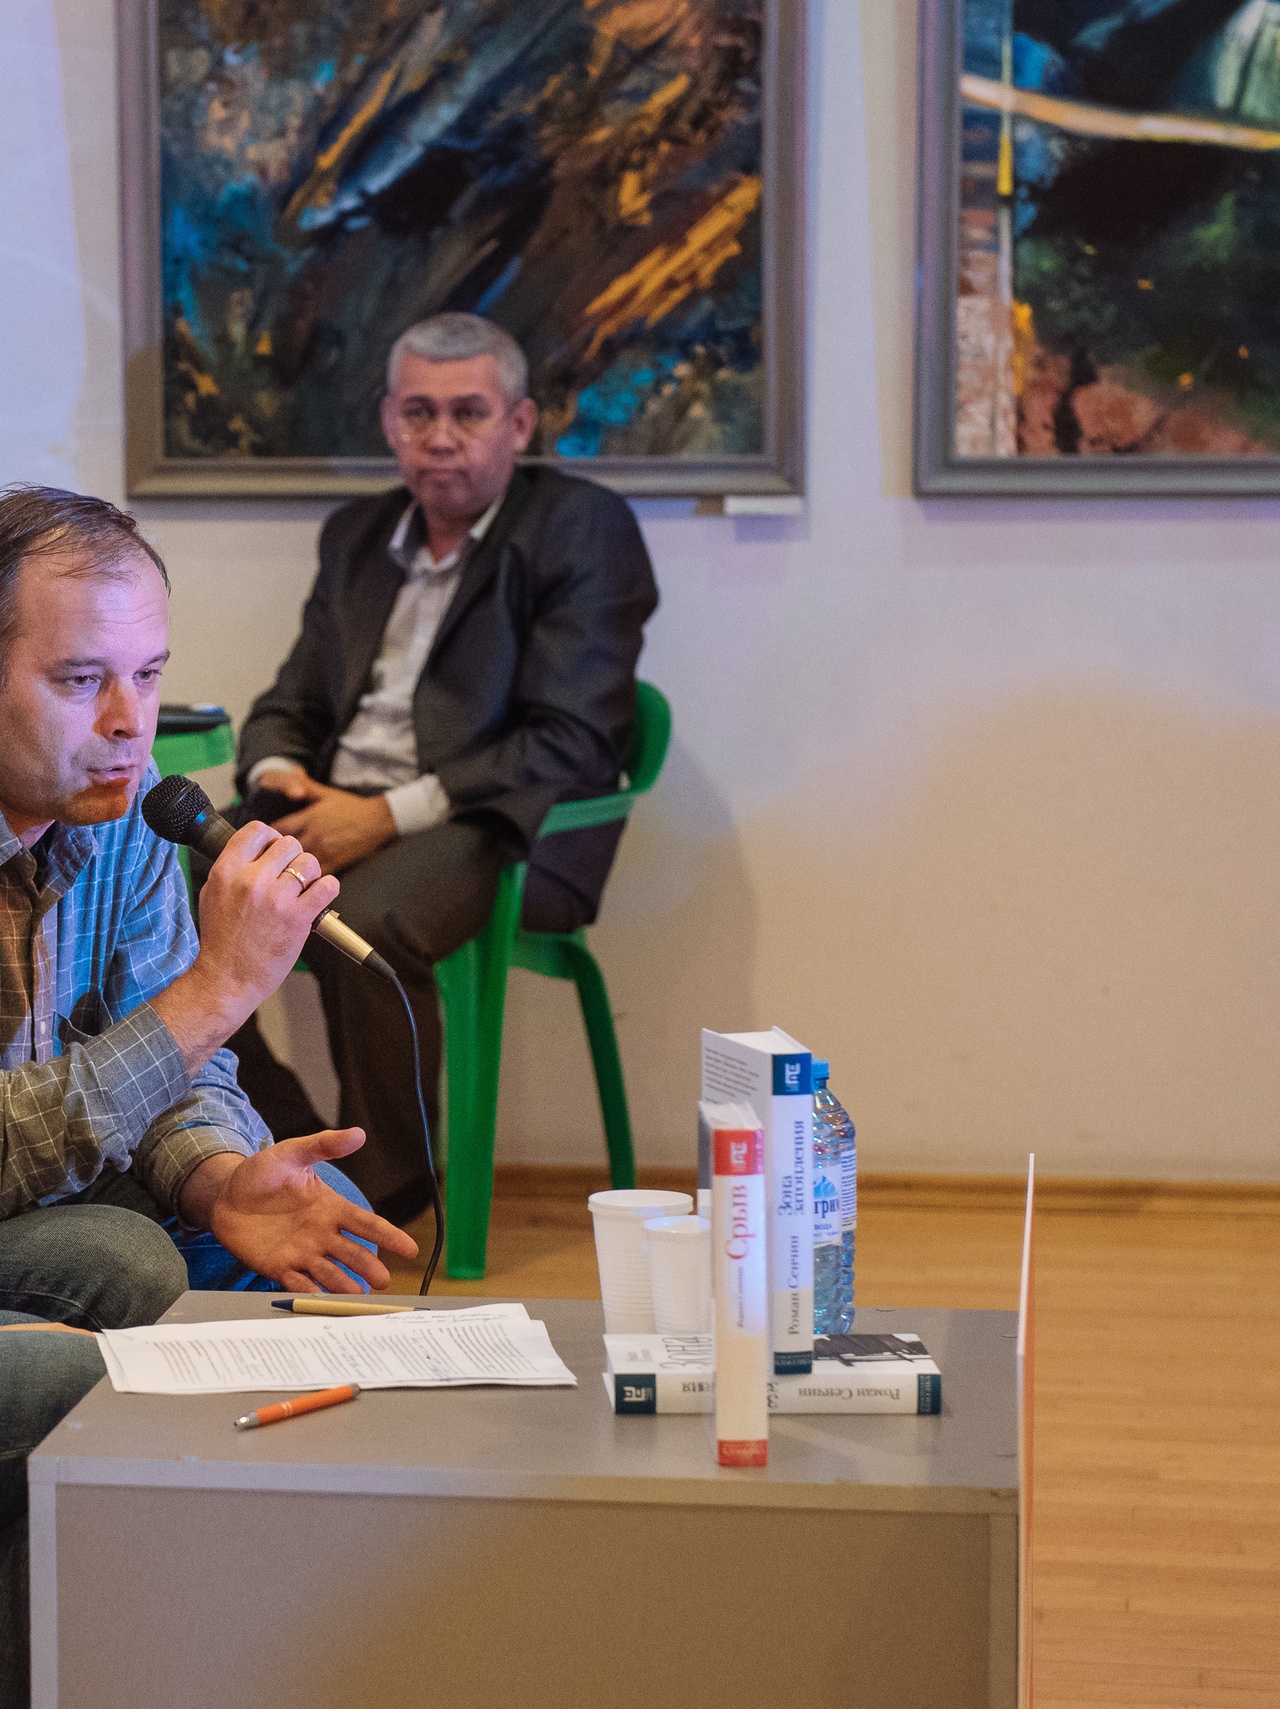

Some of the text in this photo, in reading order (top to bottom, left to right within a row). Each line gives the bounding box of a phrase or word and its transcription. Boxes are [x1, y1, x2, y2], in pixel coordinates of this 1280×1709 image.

[777, 1174, 793, 1217] Зона
[793, 1120, 805, 1217] затопления
[726, 1184, 756, 1260] Срыв
[787, 1235, 800, 1336] Роман Сенчин
[797, 1385, 901, 1400] Роман Сенчин
